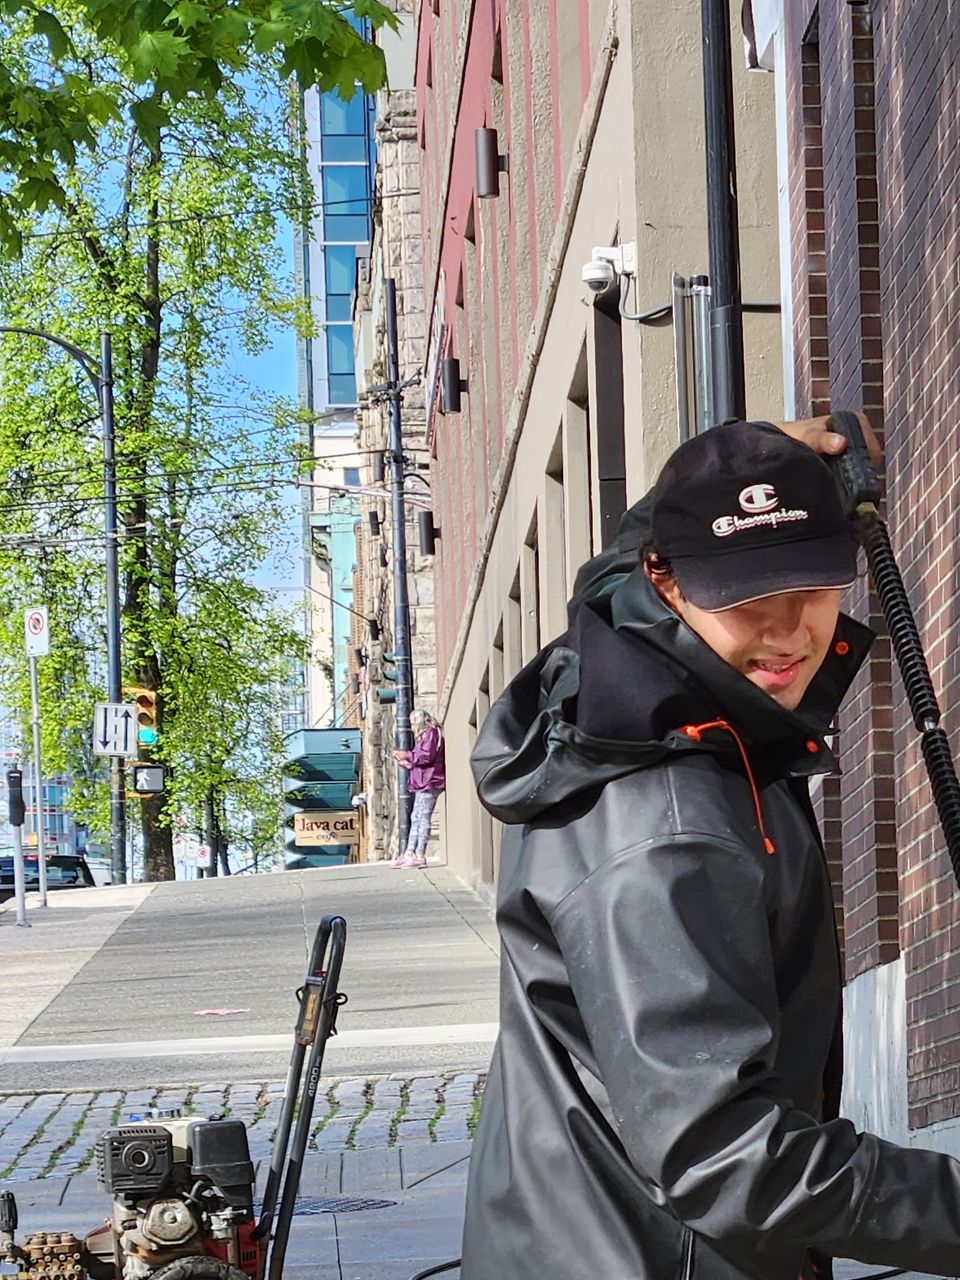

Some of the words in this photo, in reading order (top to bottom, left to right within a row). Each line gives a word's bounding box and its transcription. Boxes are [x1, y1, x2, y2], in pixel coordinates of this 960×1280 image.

[711, 508, 808, 537] Champion
[299, 818, 330, 831] Java
[333, 818, 355, 831] cat
[308, 1067, 320, 1097] 4200
